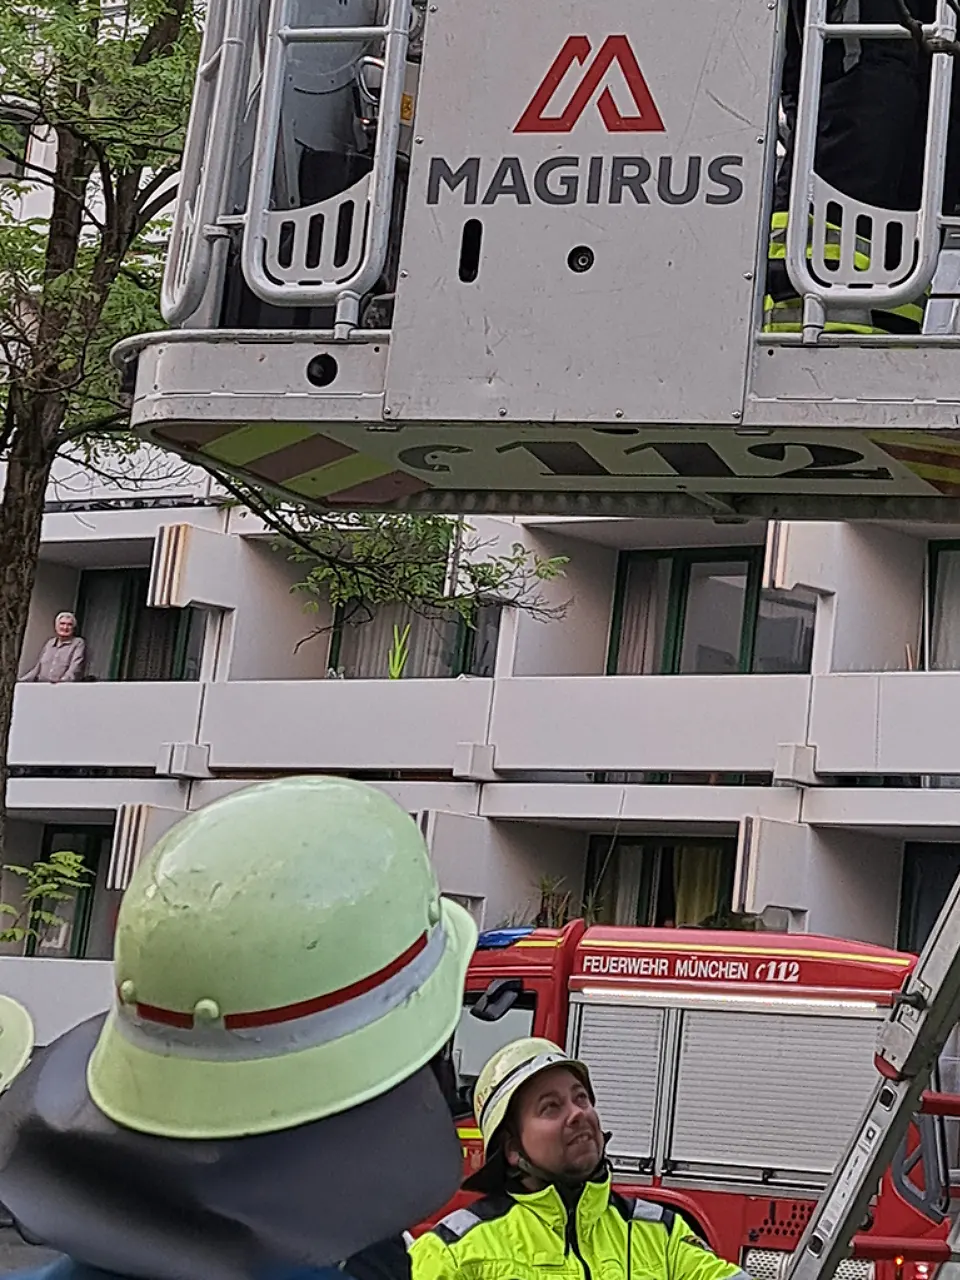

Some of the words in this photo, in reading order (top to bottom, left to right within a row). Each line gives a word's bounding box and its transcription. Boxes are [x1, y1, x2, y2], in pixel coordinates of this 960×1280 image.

[427, 156, 744, 205] MAGIRUS
[494, 440, 892, 480] 112
[583, 956, 668, 976] FEUERWEHR
[675, 957, 748, 979] MÜNCHEN
[766, 960, 800, 982] 112
